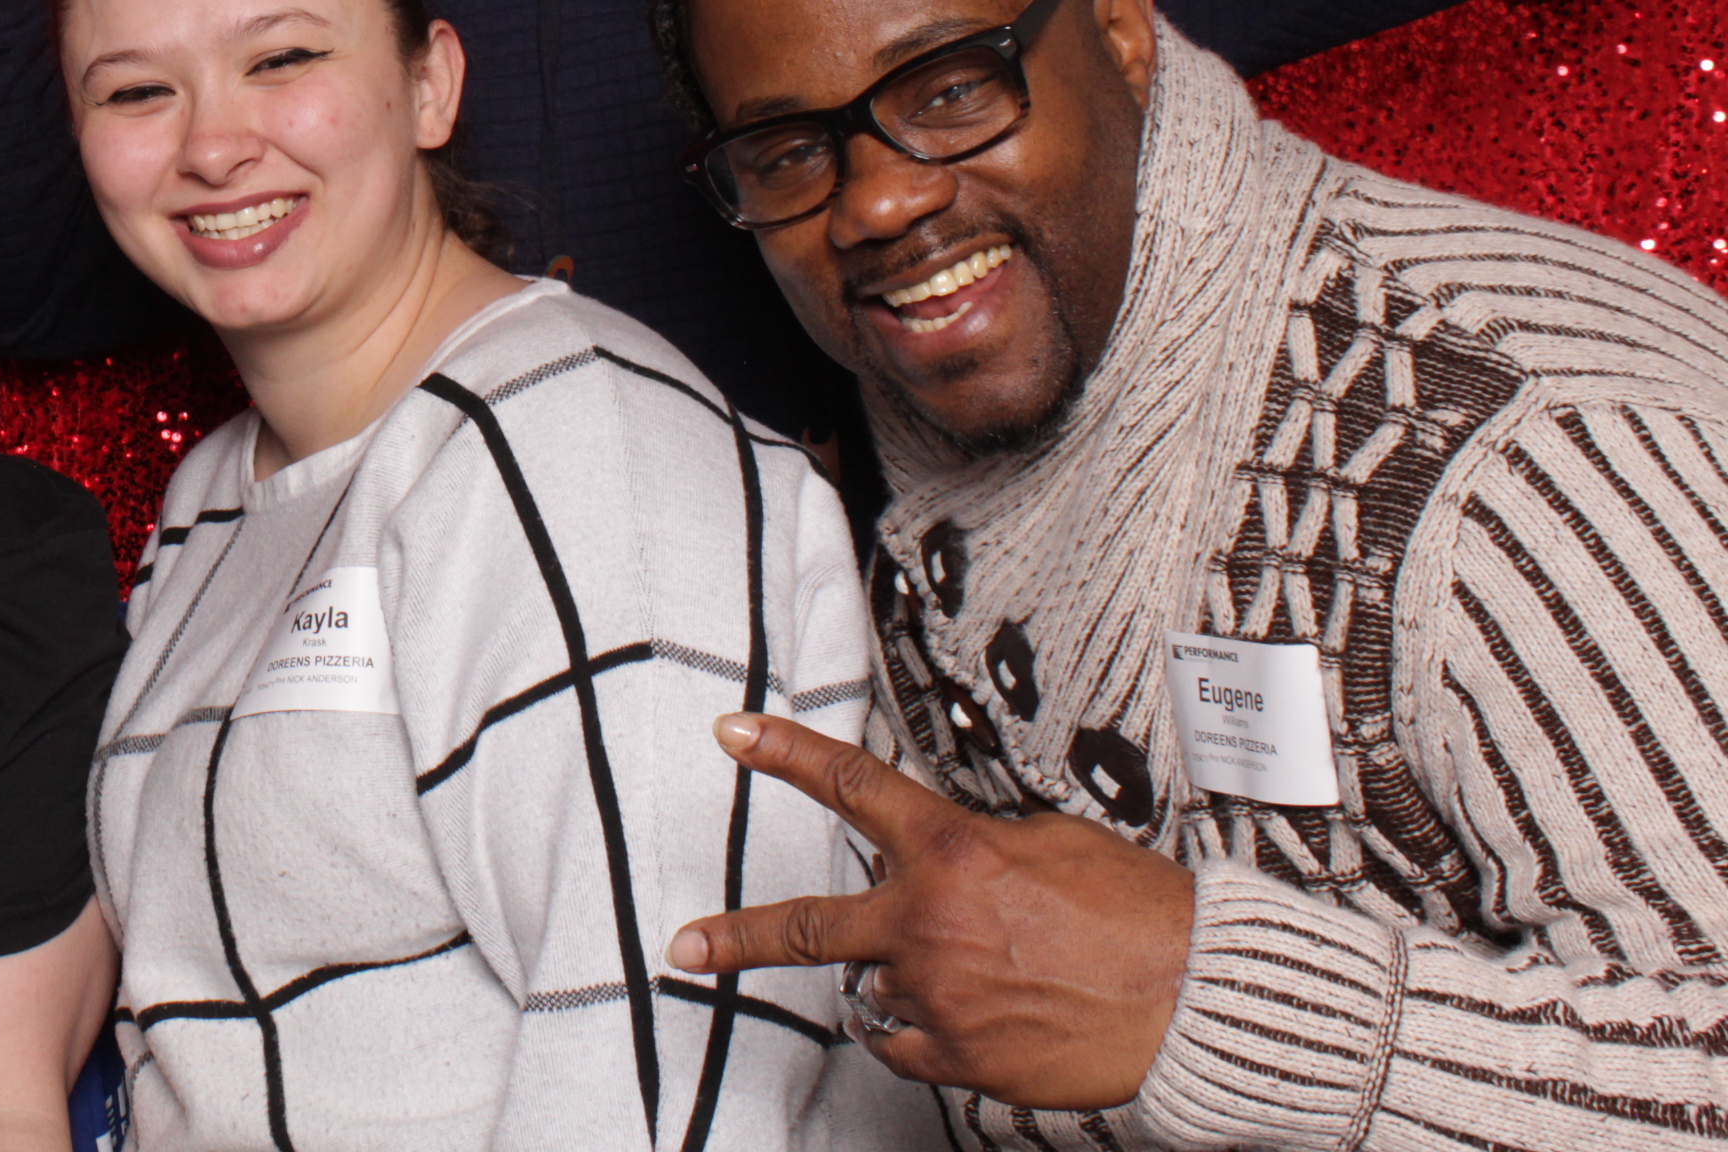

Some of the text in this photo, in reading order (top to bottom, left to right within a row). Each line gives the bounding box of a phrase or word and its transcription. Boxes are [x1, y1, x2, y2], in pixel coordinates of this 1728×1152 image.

[290, 605, 349, 634] Kayla
[267, 655, 375, 672] DOREENS PIZZERIA
[1184, 646, 1239, 663] PERFORMANCE
[287, 675, 305, 684] NICK
[306, 675, 358, 684] ANDERSON
[1198, 677, 1264, 712] Eugene
[1194, 730, 1278, 756] DOREENS PIZZERIA
